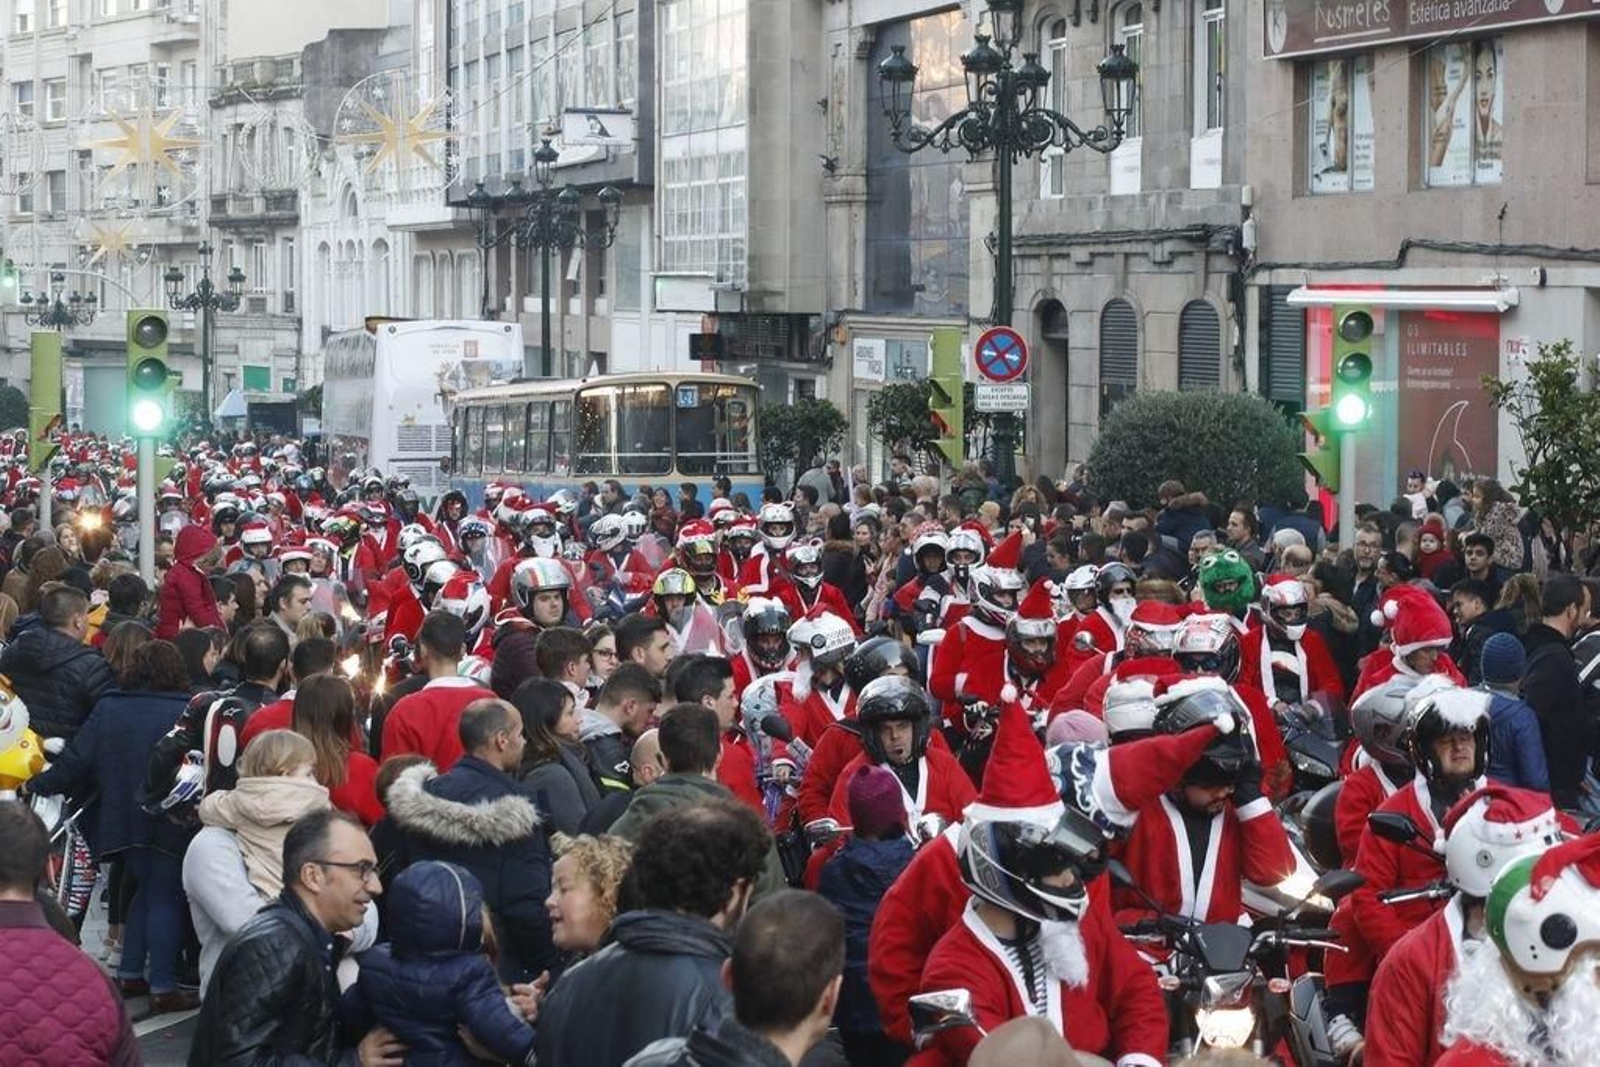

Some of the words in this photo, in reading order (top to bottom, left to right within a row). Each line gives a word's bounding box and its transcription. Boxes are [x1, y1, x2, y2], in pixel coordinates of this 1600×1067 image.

[1410, 1, 1450, 25] Estética
[1453, 0, 1511, 19] avanzada
[1406, 341, 1468, 357] ILIMITABLES
